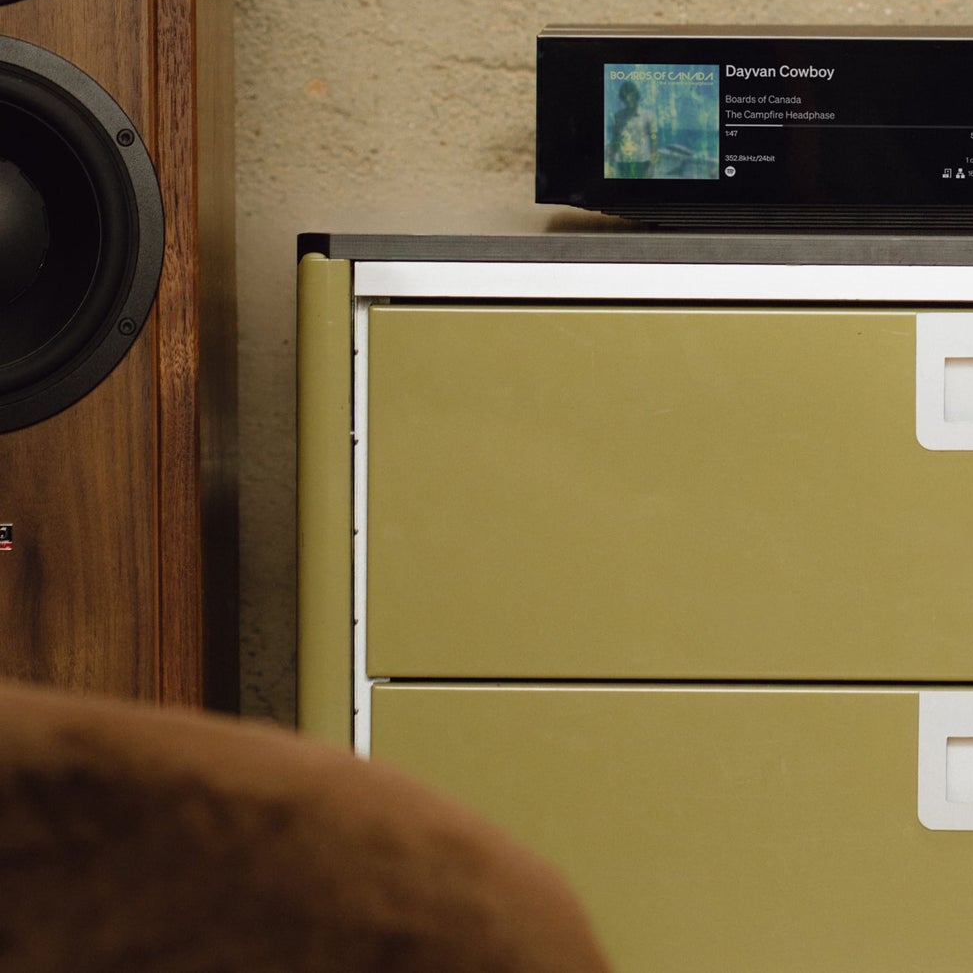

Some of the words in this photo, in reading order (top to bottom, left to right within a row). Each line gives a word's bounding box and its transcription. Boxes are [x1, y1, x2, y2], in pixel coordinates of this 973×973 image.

[610, 71, 652, 81] BOARDS
[653, 71, 666, 81] OF
[667, 71, 714, 82] CANADA
[725, 64, 777, 80] Dayvan
[779, 65, 835, 81] Cowboy
[725, 94, 757, 104] Boards
[757, 94, 767, 104] of
[768, 95, 802, 105] Canada
[725, 109, 742, 119] The
[743, 110, 784, 121] Campfire
[785, 110, 836, 122] Headphase
